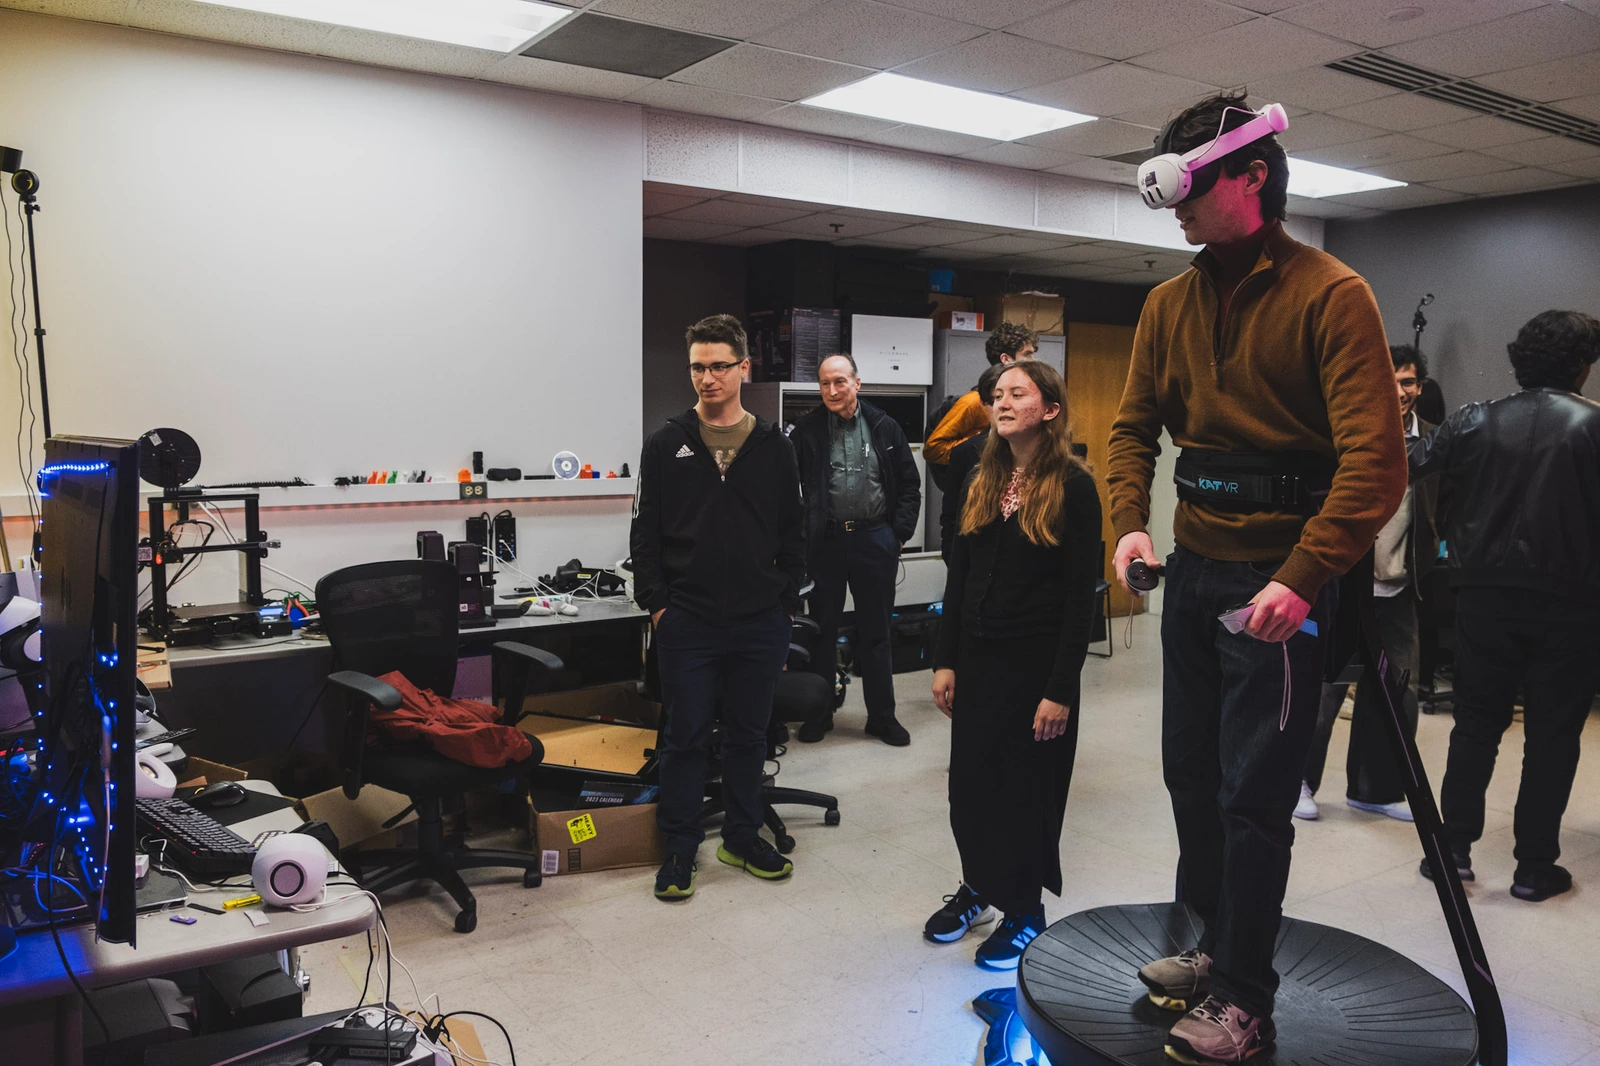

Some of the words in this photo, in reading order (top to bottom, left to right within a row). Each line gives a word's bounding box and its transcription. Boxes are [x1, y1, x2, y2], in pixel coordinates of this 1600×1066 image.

[1198, 477, 1222, 491] KAT
[1223, 481, 1239, 494] VR
[583, 815, 593, 835] HEAVY
